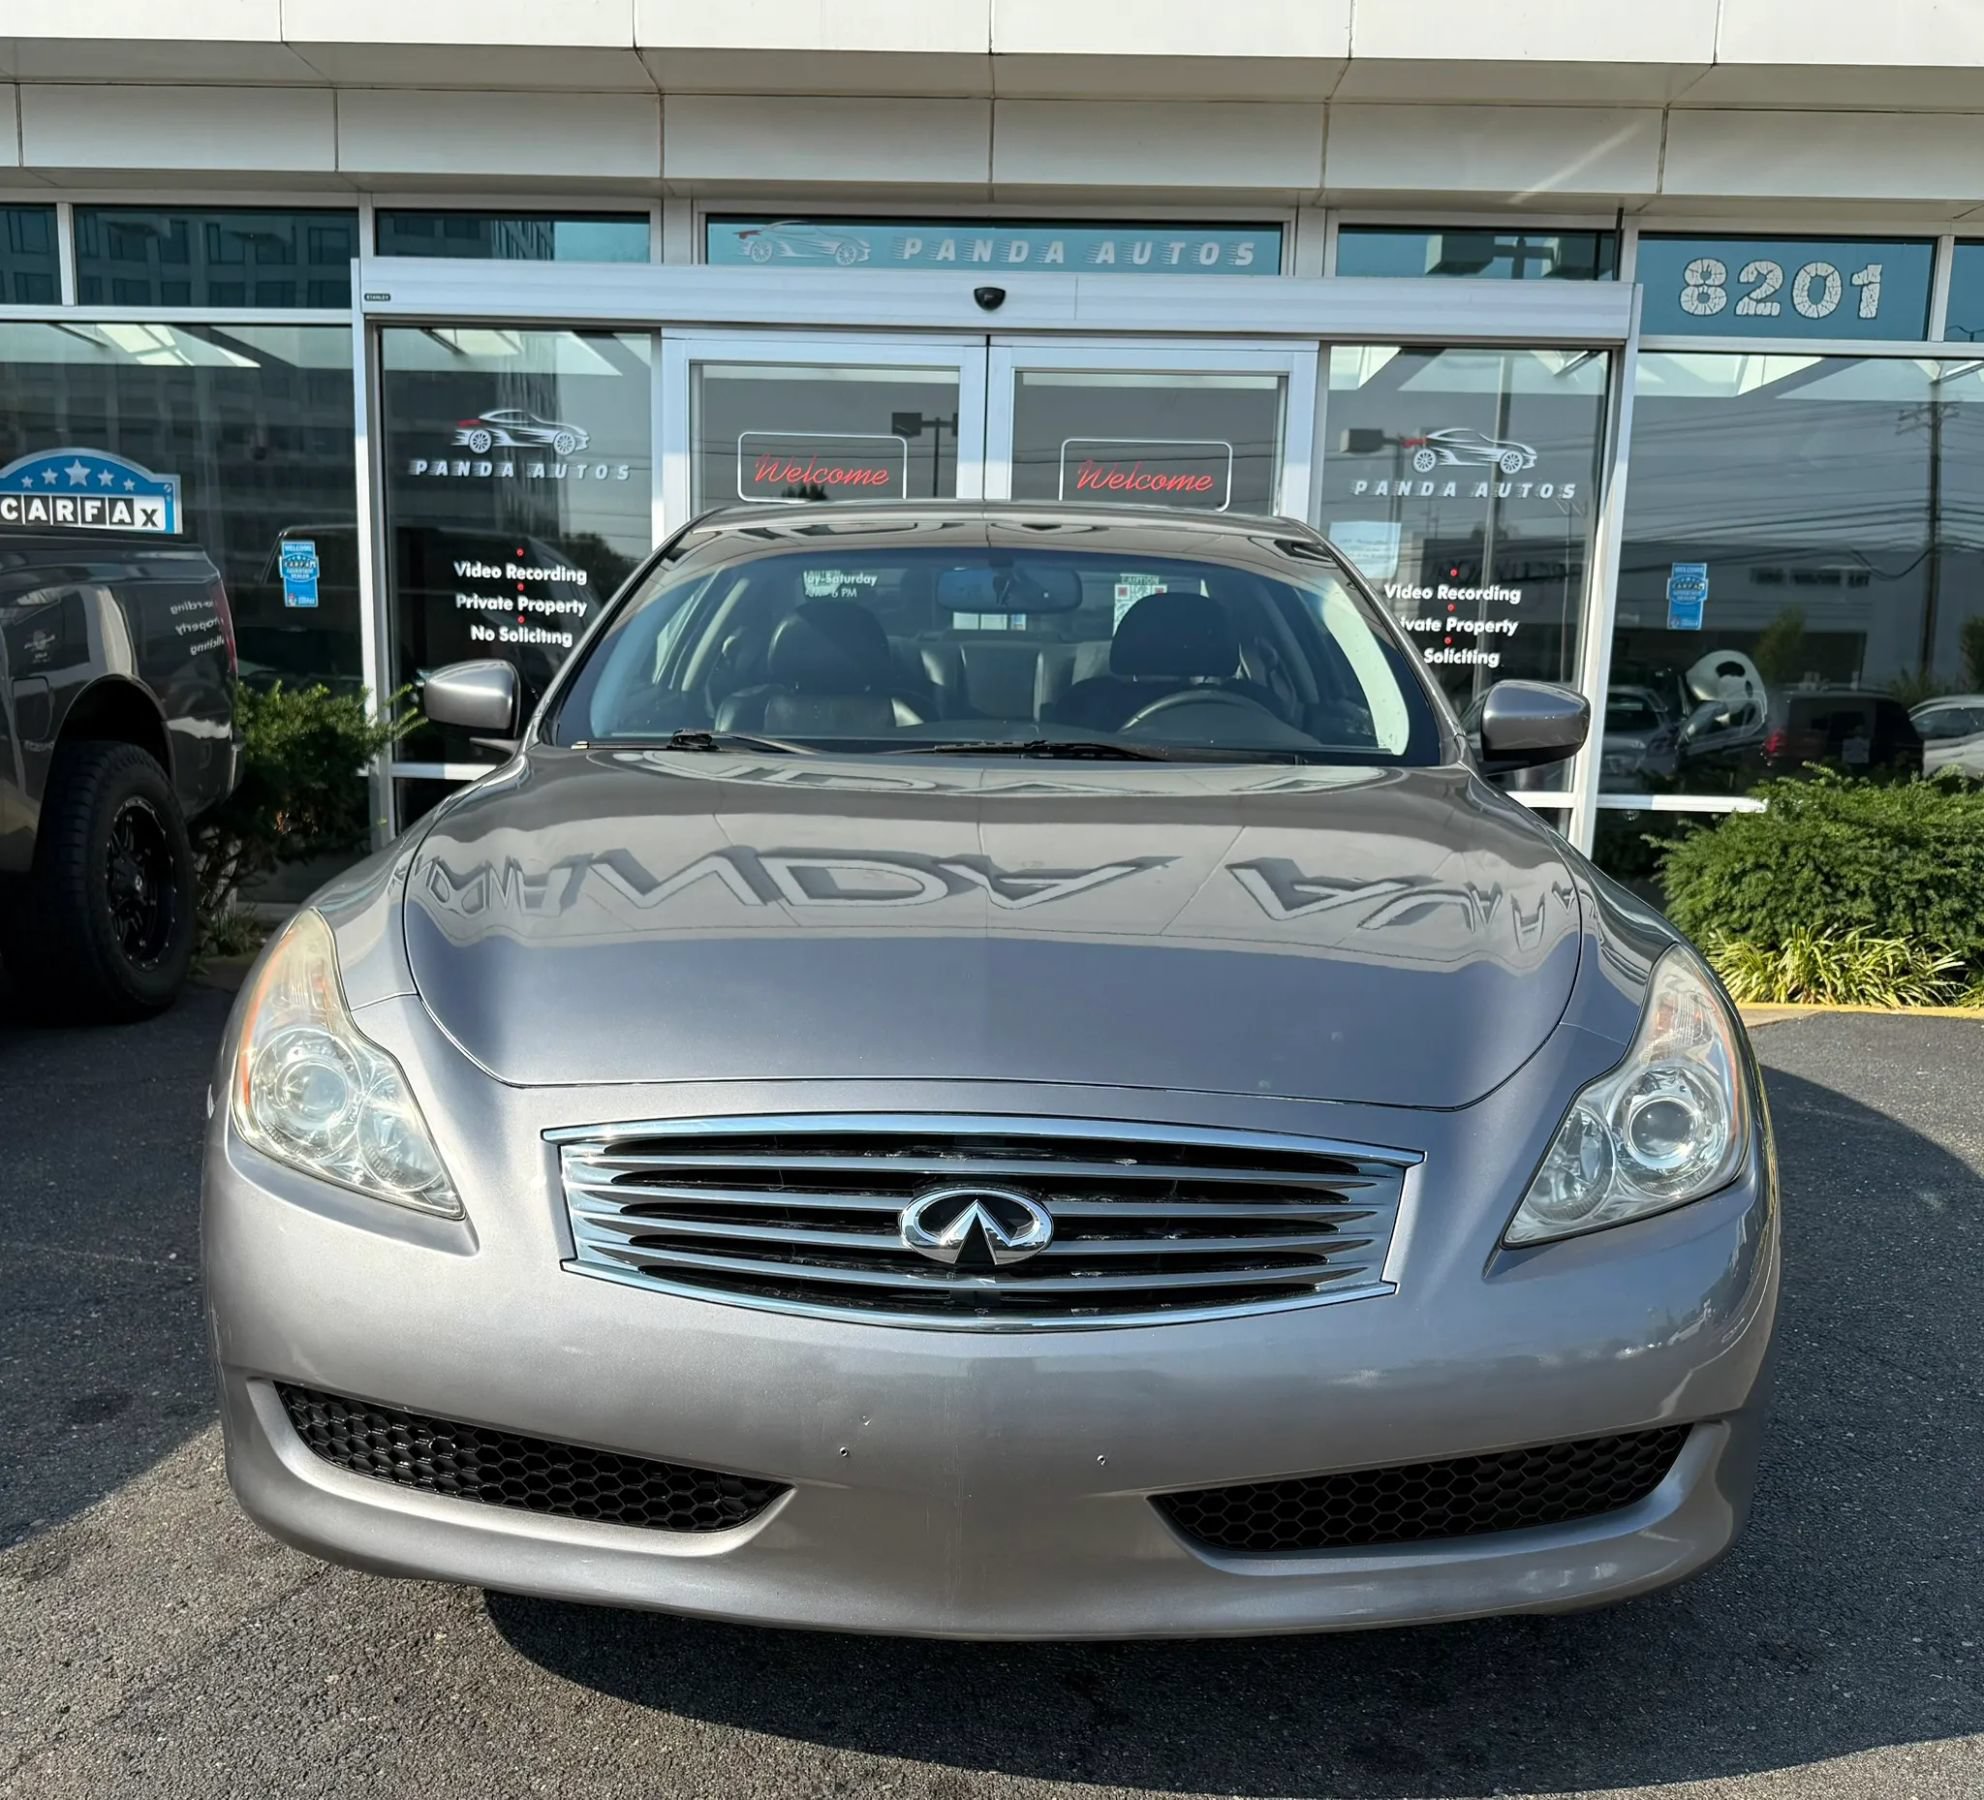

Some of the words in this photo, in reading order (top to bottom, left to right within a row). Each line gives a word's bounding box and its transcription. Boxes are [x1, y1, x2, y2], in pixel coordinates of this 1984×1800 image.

[897, 238, 1064, 263] PANDA
[1092, 241, 1255, 265] AUTOS
[1679, 257, 1883, 320] 8201
[410, 460, 515, 477] PANDA
[529, 463, 630, 480] AUTOS
[754, 453, 890, 486] Welcome
[1076, 457, 1214, 492] Welcome
[1352, 480, 1456, 497] PANDA
[1470, 482, 1577, 499] AUTOS
[0, 497, 158, 528] CARFAX
[453, 561, 502, 579] Video
[505, 562, 588, 585] Recording
[456, 592, 513, 611] Private
[517, 595, 588, 617] Property
[1384, 583, 1433, 600] Video
[1437, 583, 1522, 604] Recording
[470, 624, 495, 642] No
[498, 625, 574, 648] Soliciting
[1400, 617, 1442, 633] ivate
[1446, 617, 1520, 636] Property
[1423, 648, 1501, 668] Soliciting
